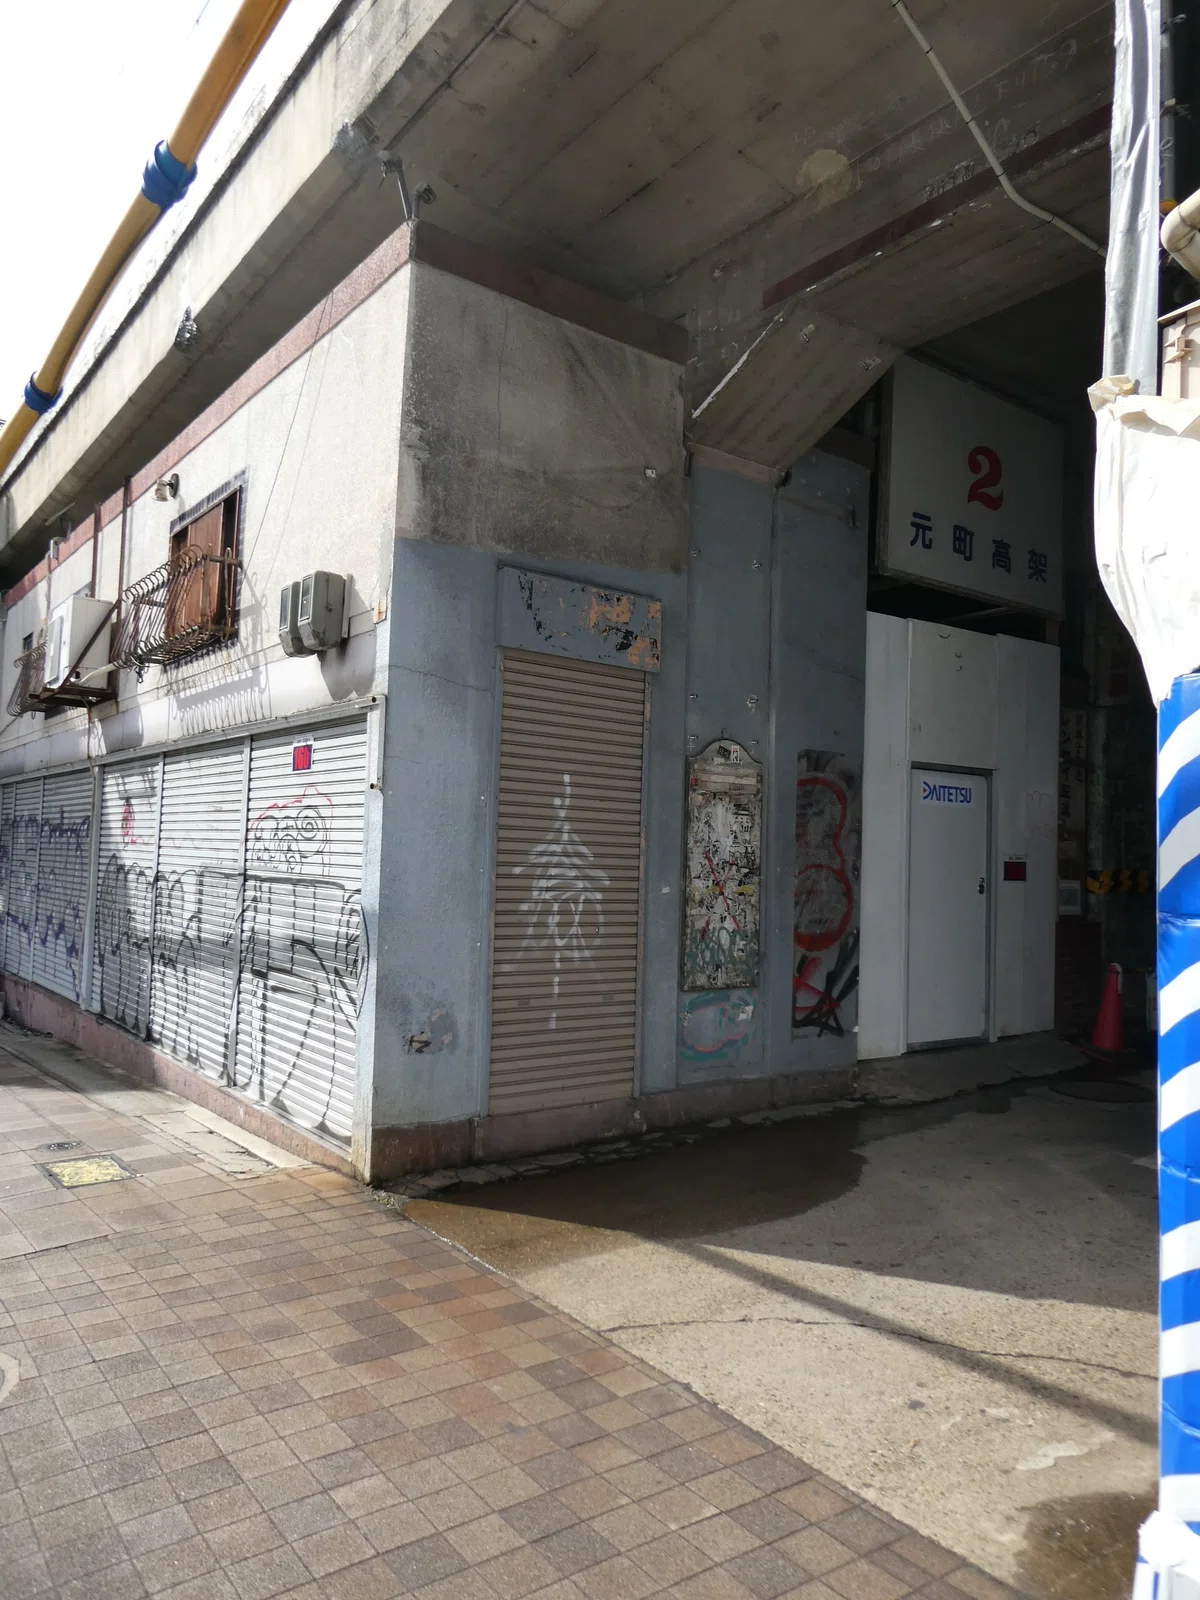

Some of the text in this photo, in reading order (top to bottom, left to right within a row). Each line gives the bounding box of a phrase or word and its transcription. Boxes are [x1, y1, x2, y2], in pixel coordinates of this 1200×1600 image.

[967, 445, 1004, 511] 2
[909, 511, 1048, 584] 元町高架
[922, 780, 972, 804] DAITETSU
